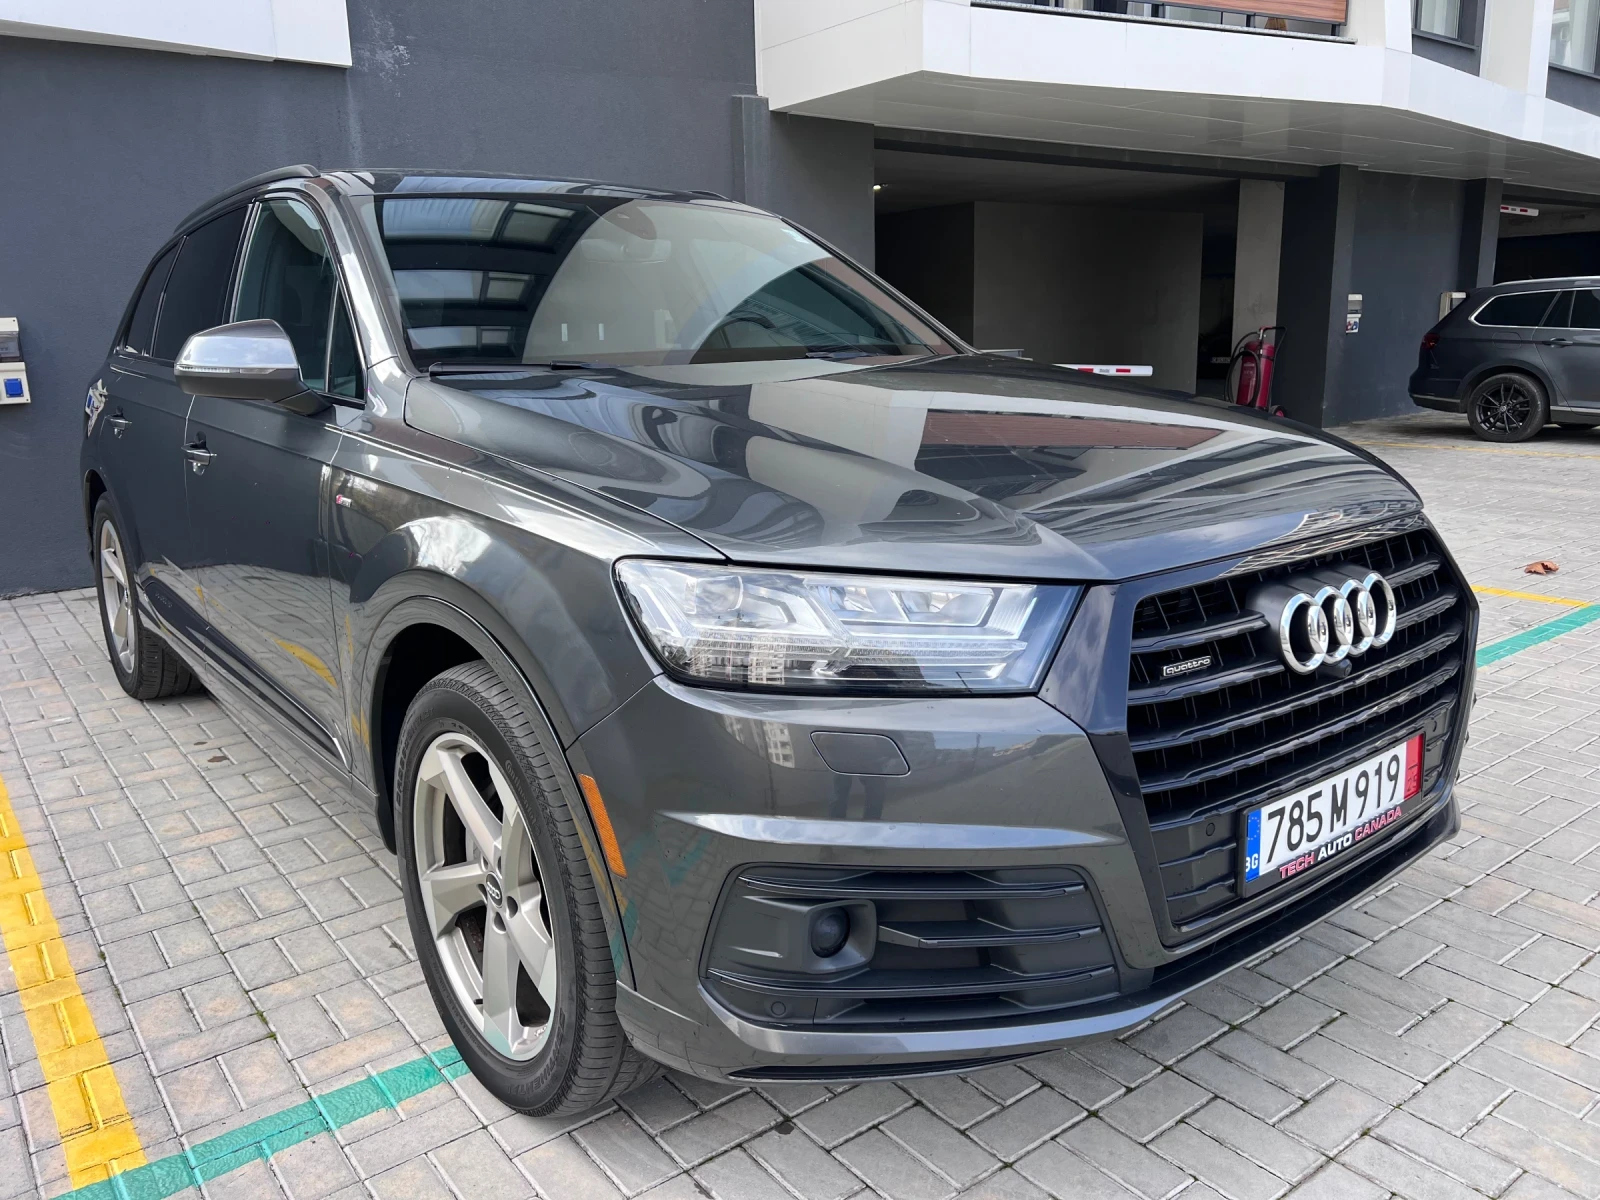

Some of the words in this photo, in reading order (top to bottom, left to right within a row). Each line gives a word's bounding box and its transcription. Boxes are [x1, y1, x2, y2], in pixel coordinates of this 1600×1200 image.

[1166, 657, 1211, 675] quattro
[1279, 851, 1315, 879] TECH
[1317, 833, 1352, 861] AUTO
[1354, 806, 1401, 841] CANADA
